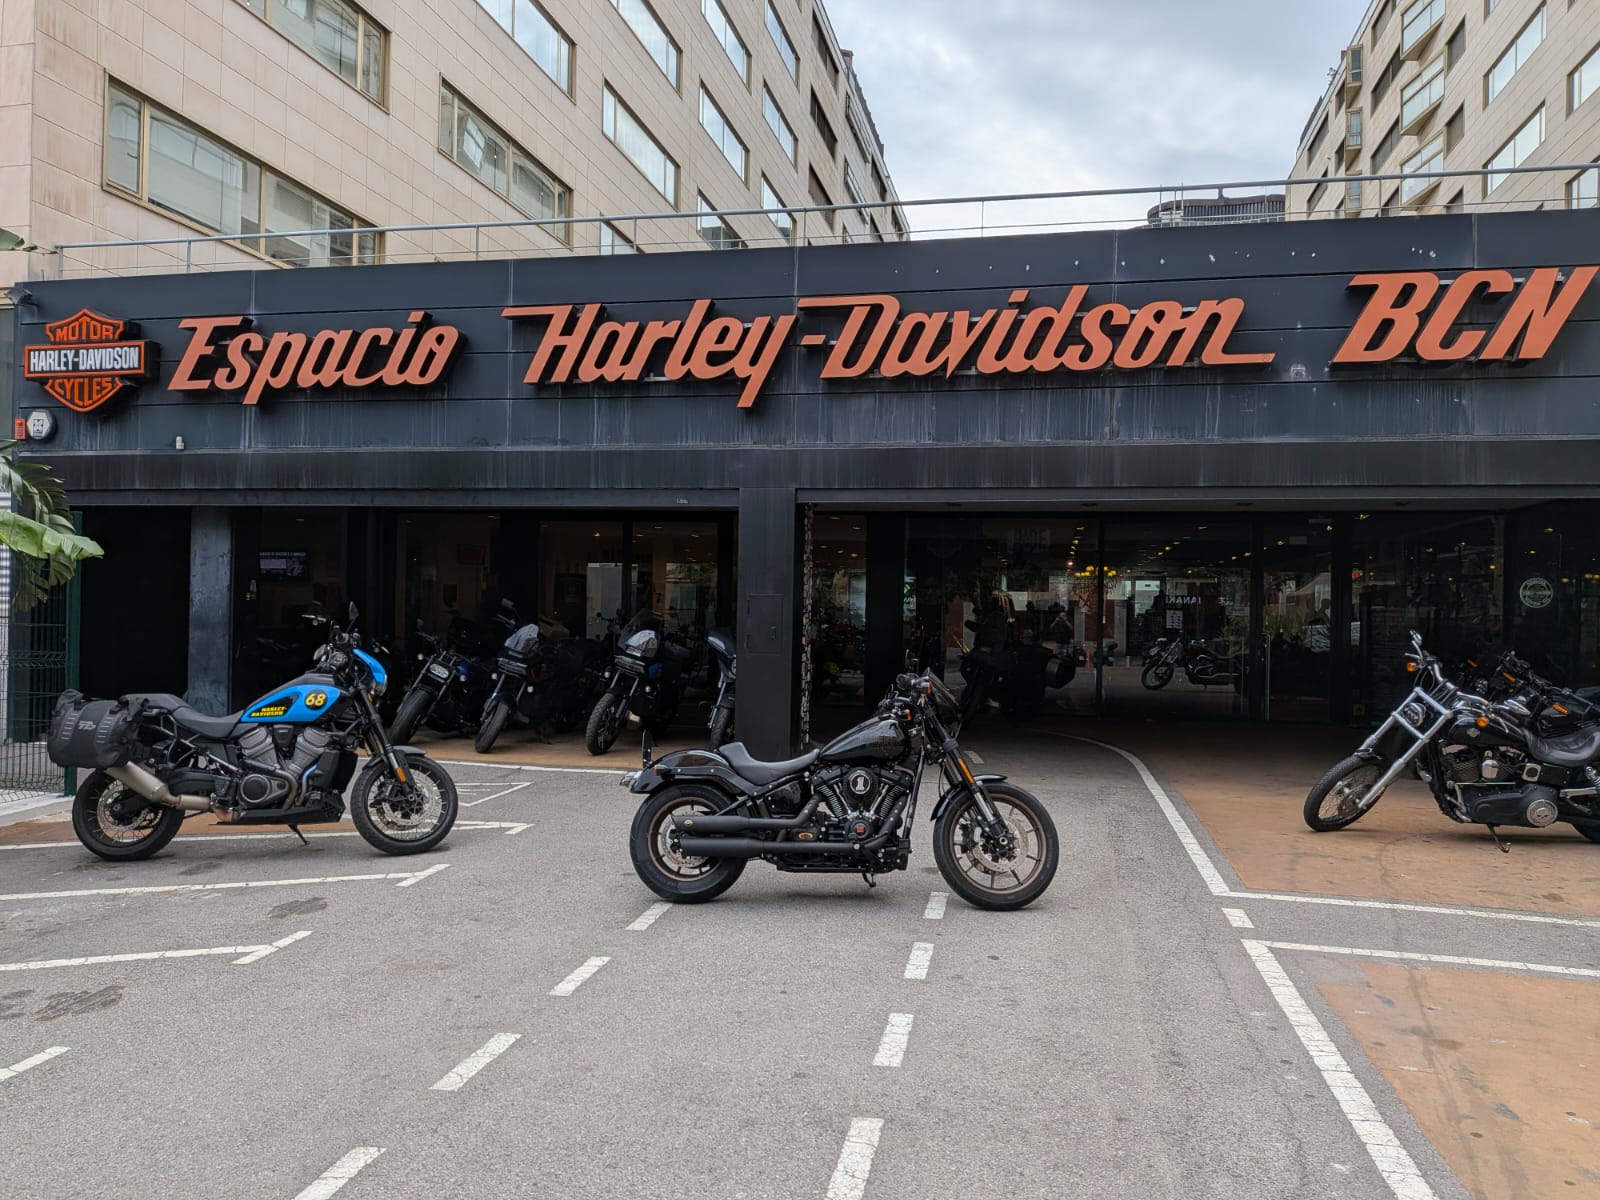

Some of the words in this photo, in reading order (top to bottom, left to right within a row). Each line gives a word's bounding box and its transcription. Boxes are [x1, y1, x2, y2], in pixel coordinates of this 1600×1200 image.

[56, 317, 113, 341] MOTOR
[168, 311, 459, 404] Espacio
[502, 284, 1275, 408] Harley-Davidson
[1333, 266, 1600, 363] BCN
[30, 347, 139, 372] HARLEY-DAVIDSON
[54, 378, 112, 406] CYCLES
[305, 693, 326, 706] 68
[855, 777, 865, 791] 1
